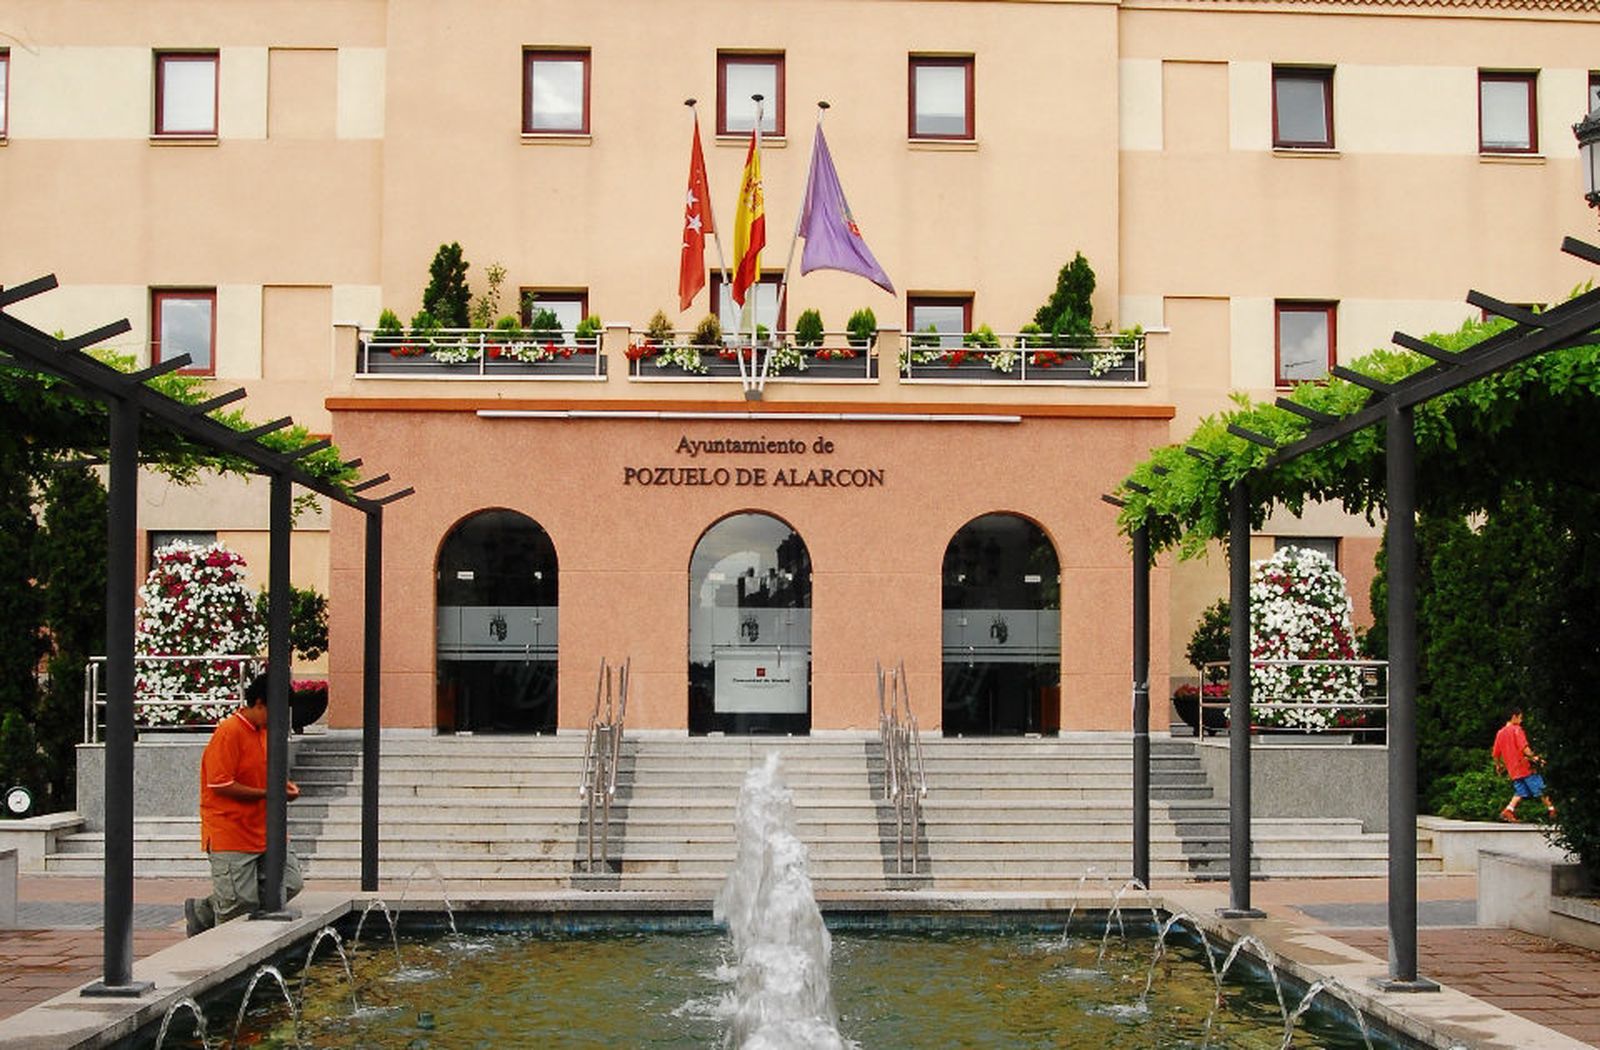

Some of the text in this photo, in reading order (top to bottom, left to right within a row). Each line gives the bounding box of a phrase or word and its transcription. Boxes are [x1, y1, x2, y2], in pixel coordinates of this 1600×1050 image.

[675, 436, 834, 458] Ayuntamiento de
[623, 467, 885, 487] POZUELO DE ALARCON
